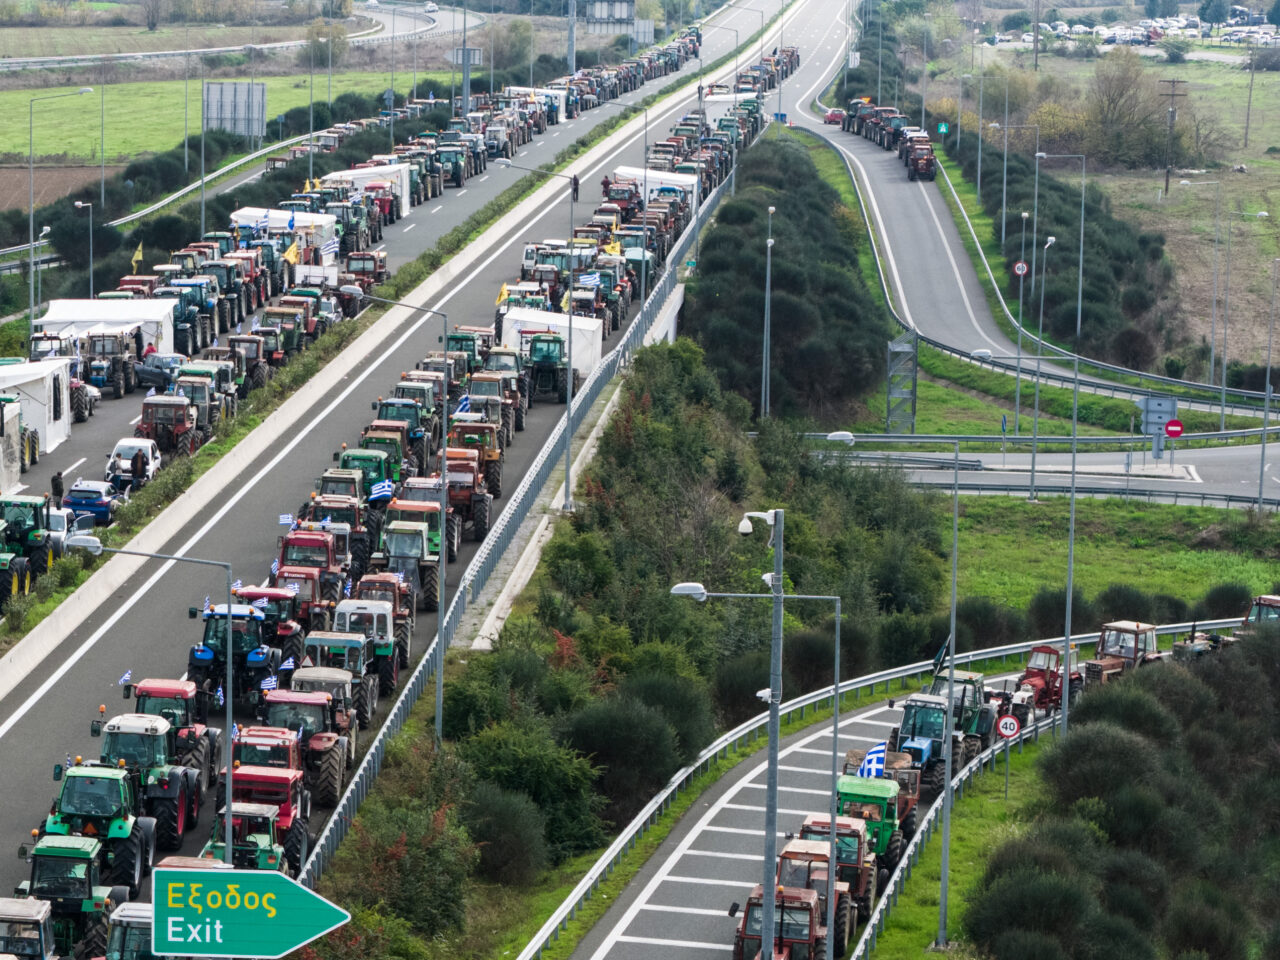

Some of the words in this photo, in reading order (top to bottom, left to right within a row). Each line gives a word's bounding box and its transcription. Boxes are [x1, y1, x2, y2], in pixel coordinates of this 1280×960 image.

[1001, 721, 1015, 731] 40
[168, 883, 276, 918] Εξοδος
[167, 917, 223, 943] Exit
